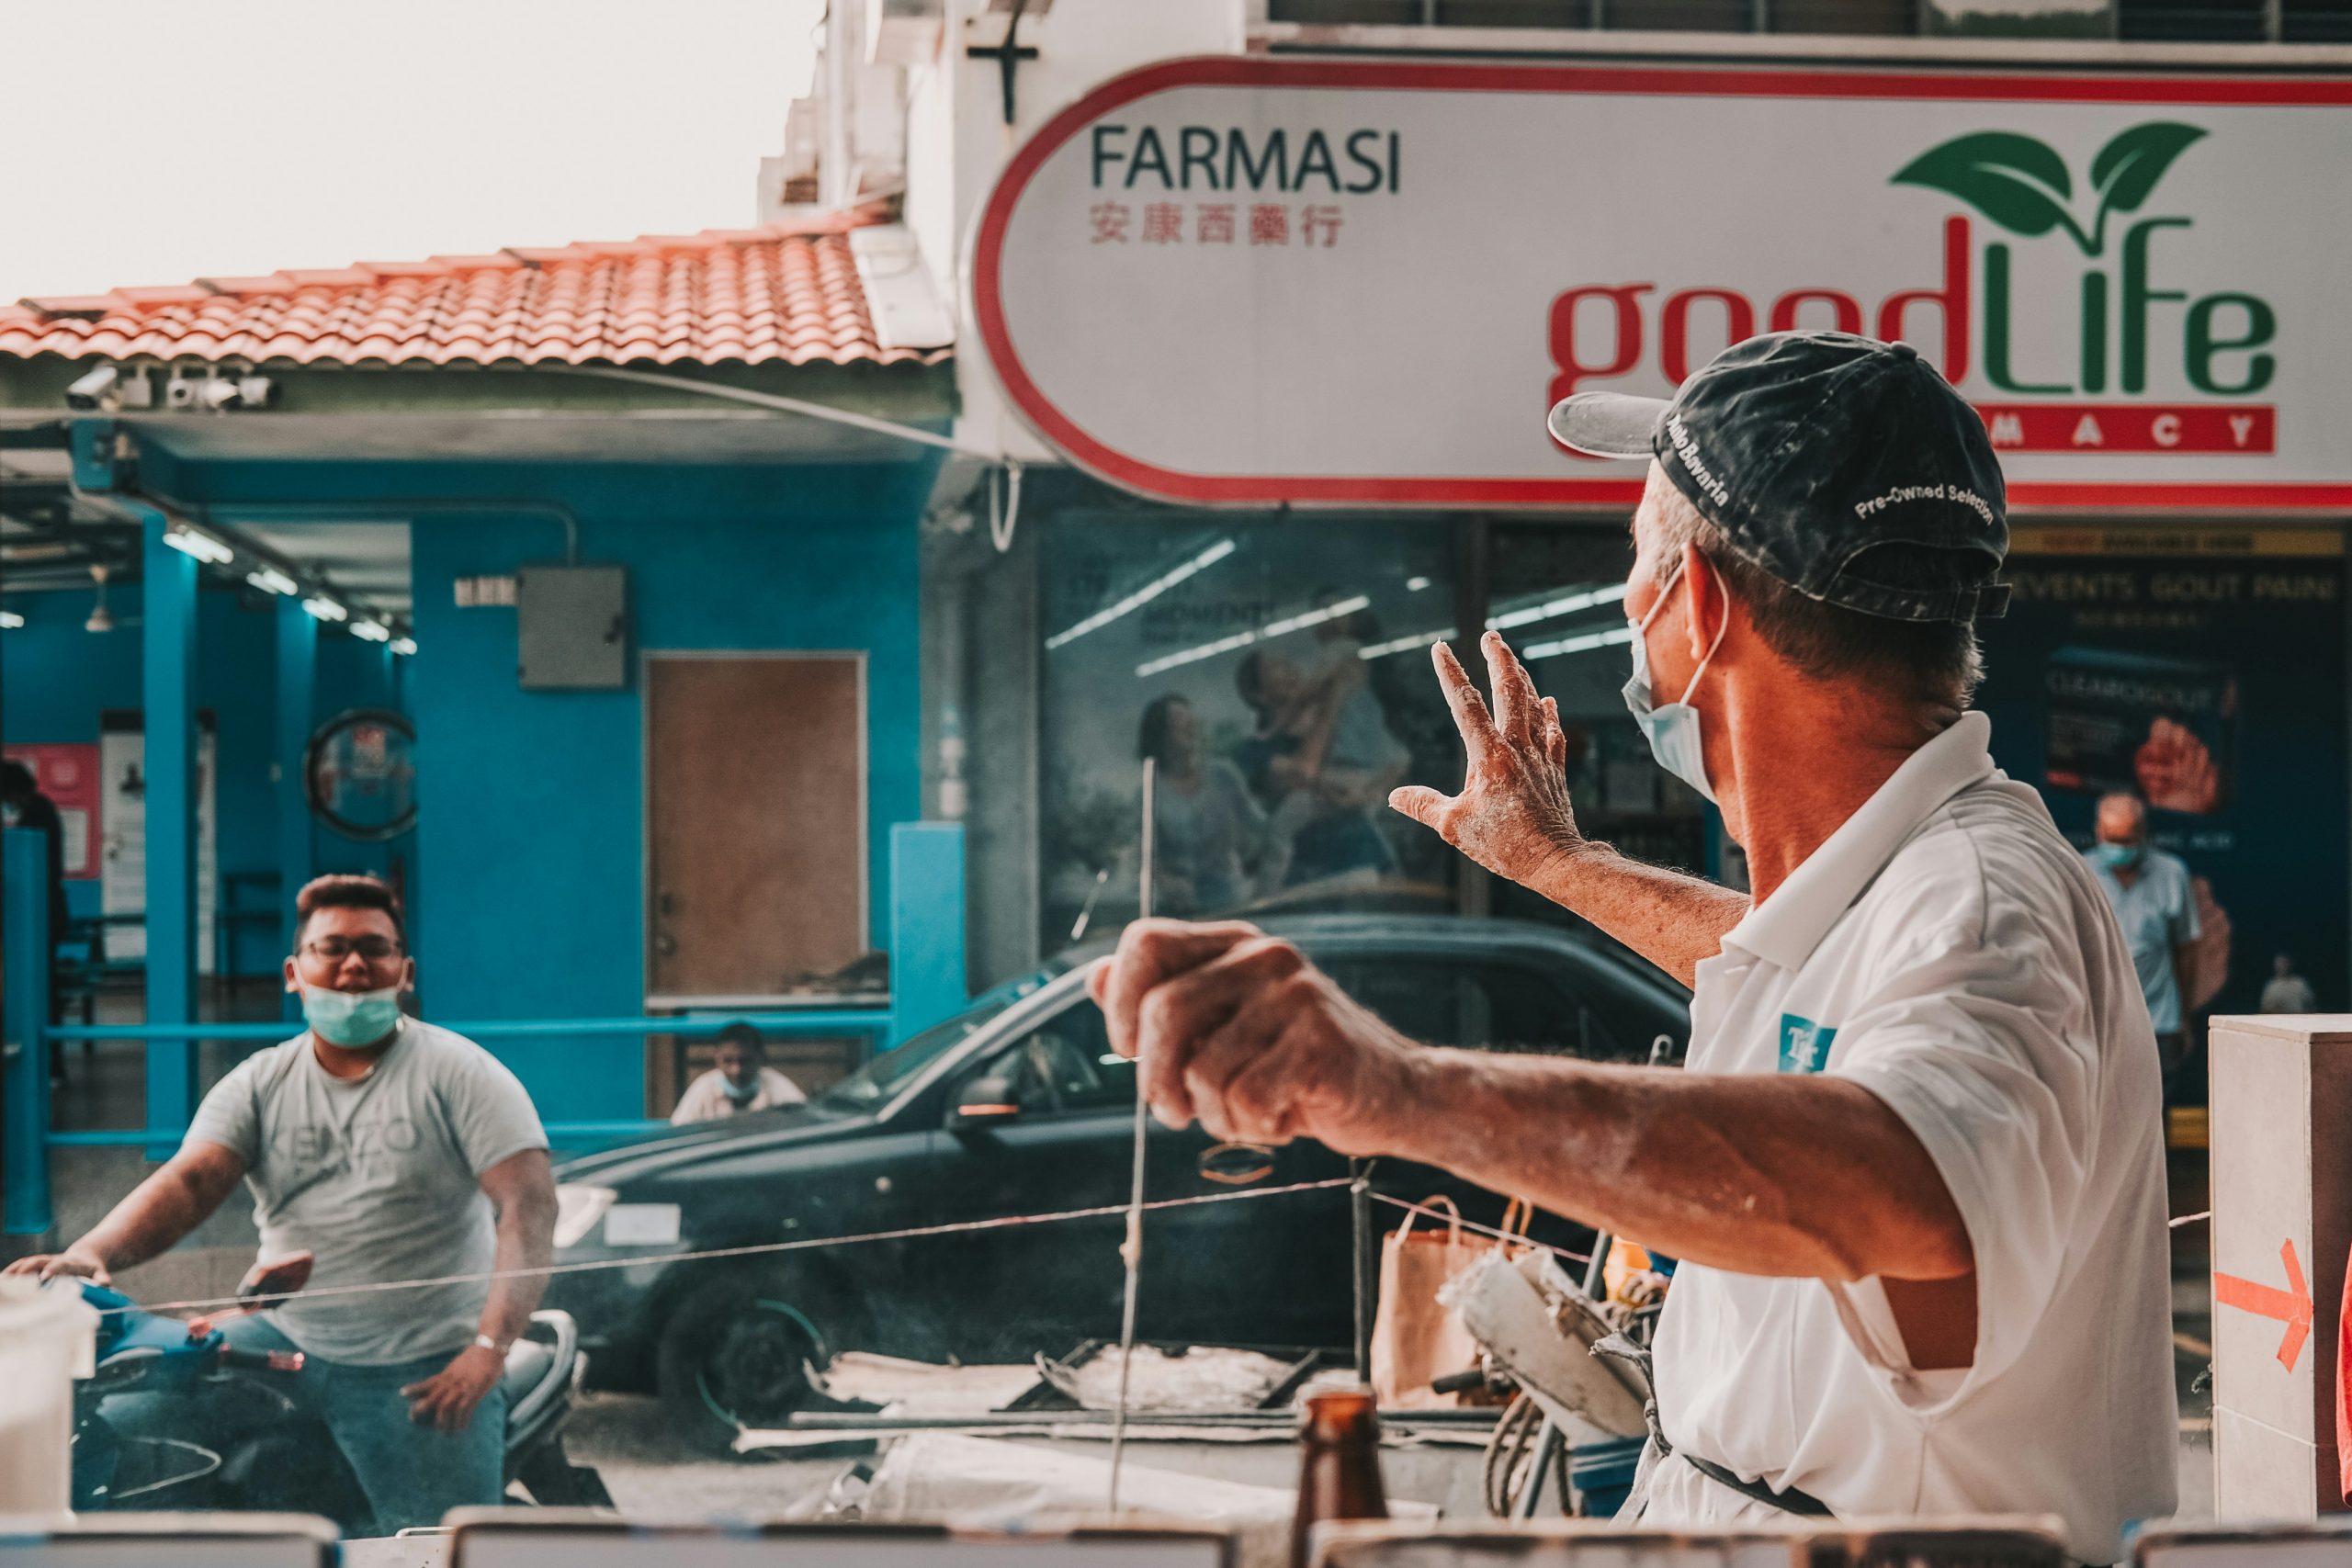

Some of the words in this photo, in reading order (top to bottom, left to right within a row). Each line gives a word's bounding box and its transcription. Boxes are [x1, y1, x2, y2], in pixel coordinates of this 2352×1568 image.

[1091, 125, 1400, 195] FARMASI
[1090, 199, 1344, 248] 安康西藥行
[1991, 413, 2254, 447] MACY
[1678, 441, 1729, 508] Bavaria
[1854, 482, 1945, 520] Pre-Owned
[1948, 484, 1995, 526] Selection
[2001, 571, 2136, 600] EVENTS
[2149, 572, 2242, 601] GOUT
